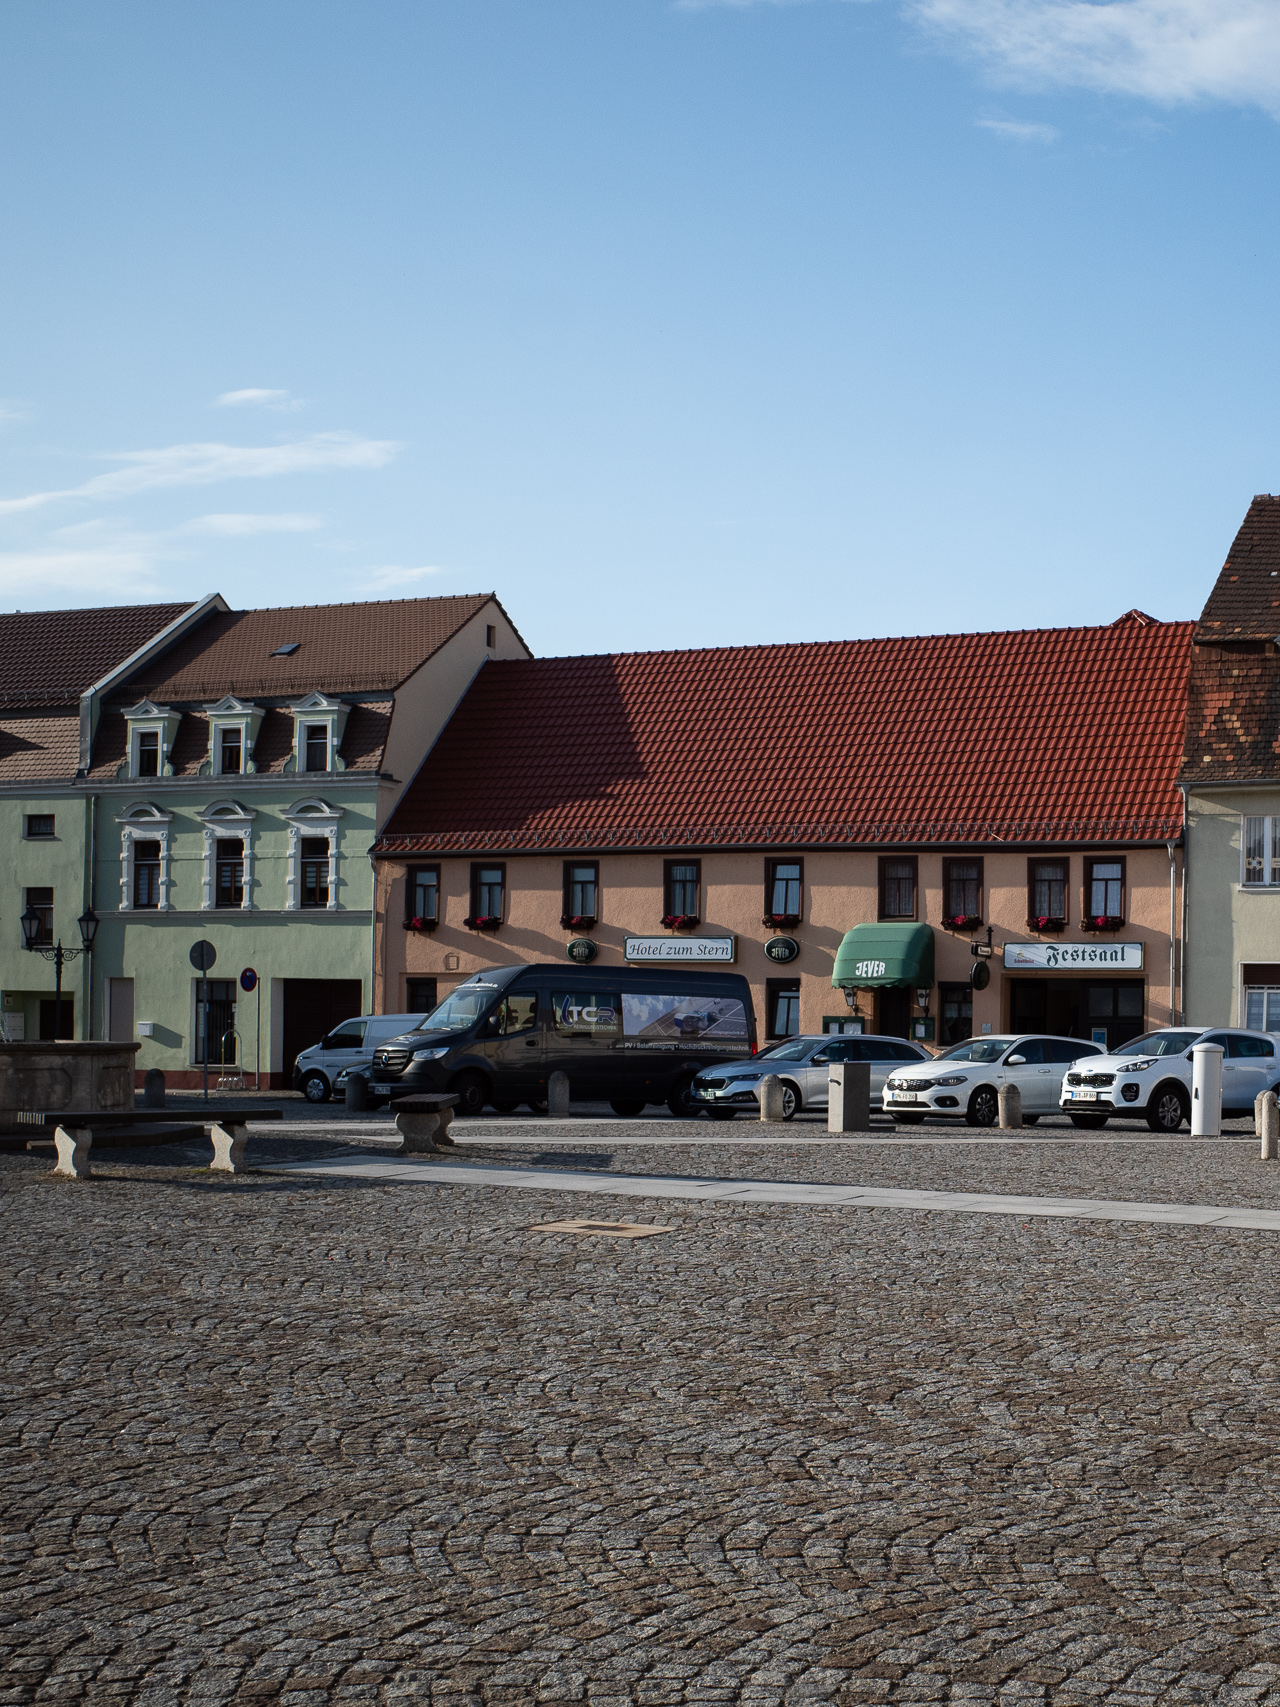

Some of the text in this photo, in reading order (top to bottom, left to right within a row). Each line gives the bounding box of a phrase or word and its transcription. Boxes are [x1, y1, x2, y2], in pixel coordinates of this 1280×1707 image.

[572, 948, 589, 957] JEVER
[628, 943, 730, 956] Hotel zum Stern
[771, 947, 790, 958] JEVER
[1046, 945, 1126, 967] Festsaal
[855, 960, 886, 978] JEVER
[568, 1006, 616, 1024] TCR
